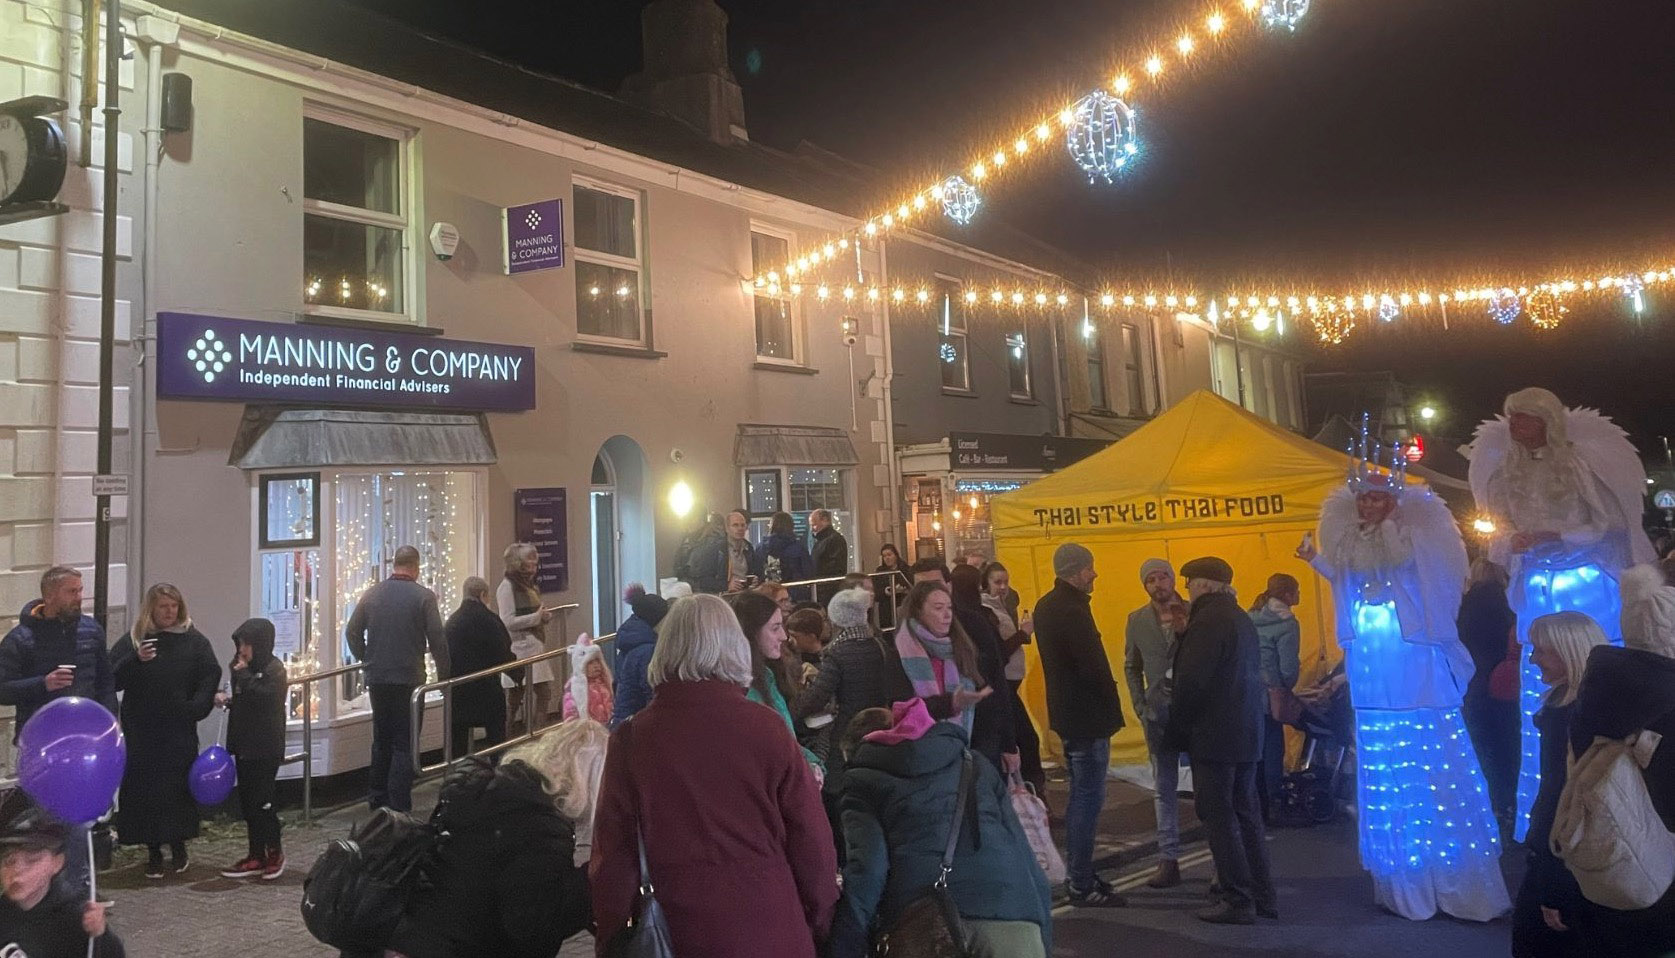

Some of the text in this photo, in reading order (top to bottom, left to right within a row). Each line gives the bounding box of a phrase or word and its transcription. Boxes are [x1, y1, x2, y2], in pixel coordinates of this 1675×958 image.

[515, 234, 553, 248] MANNING
[519, 245, 558, 258] COMPANY
[239, 332, 522, 382] MANNING & COMPANY
[239, 368, 450, 394] Independent Financial Advisers
[1224, 494, 1284, 518] FOOD
